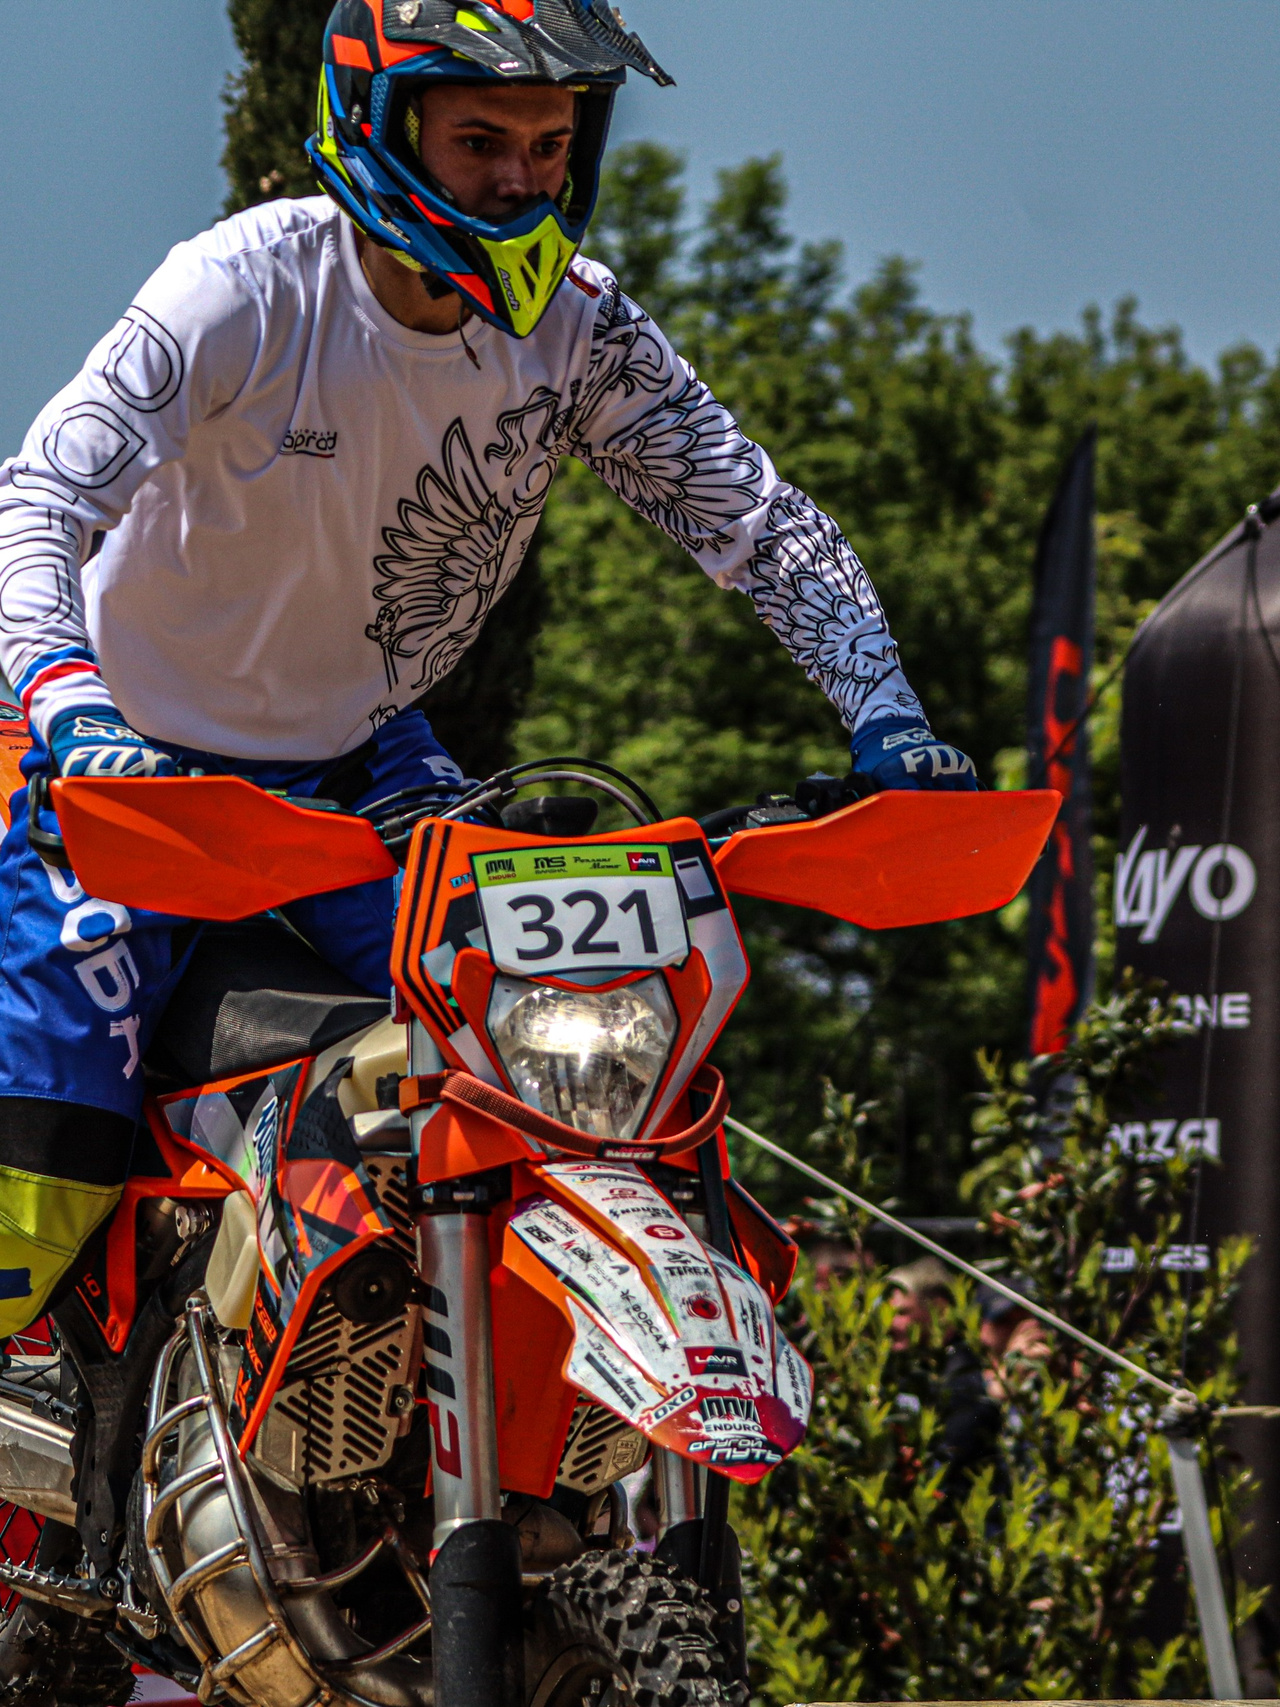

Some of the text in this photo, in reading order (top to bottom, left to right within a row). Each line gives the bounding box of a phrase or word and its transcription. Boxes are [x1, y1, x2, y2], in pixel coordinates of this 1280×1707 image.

[498, 266, 520, 311] Airoh
[62, 745, 172, 777] FOX
[488, 872, 517, 881] ENDURO
[506, 889, 659, 961] 321
[631, 1304, 670, 1353] ФОРСАЖ
[694, 1354, 738, 1366] LAVR
[705, 1422, 762, 1433] ENDURO
[689, 1437, 763, 1452] ДРУГОЙ
[711, 1447, 783, 1463] ПУТЬ
